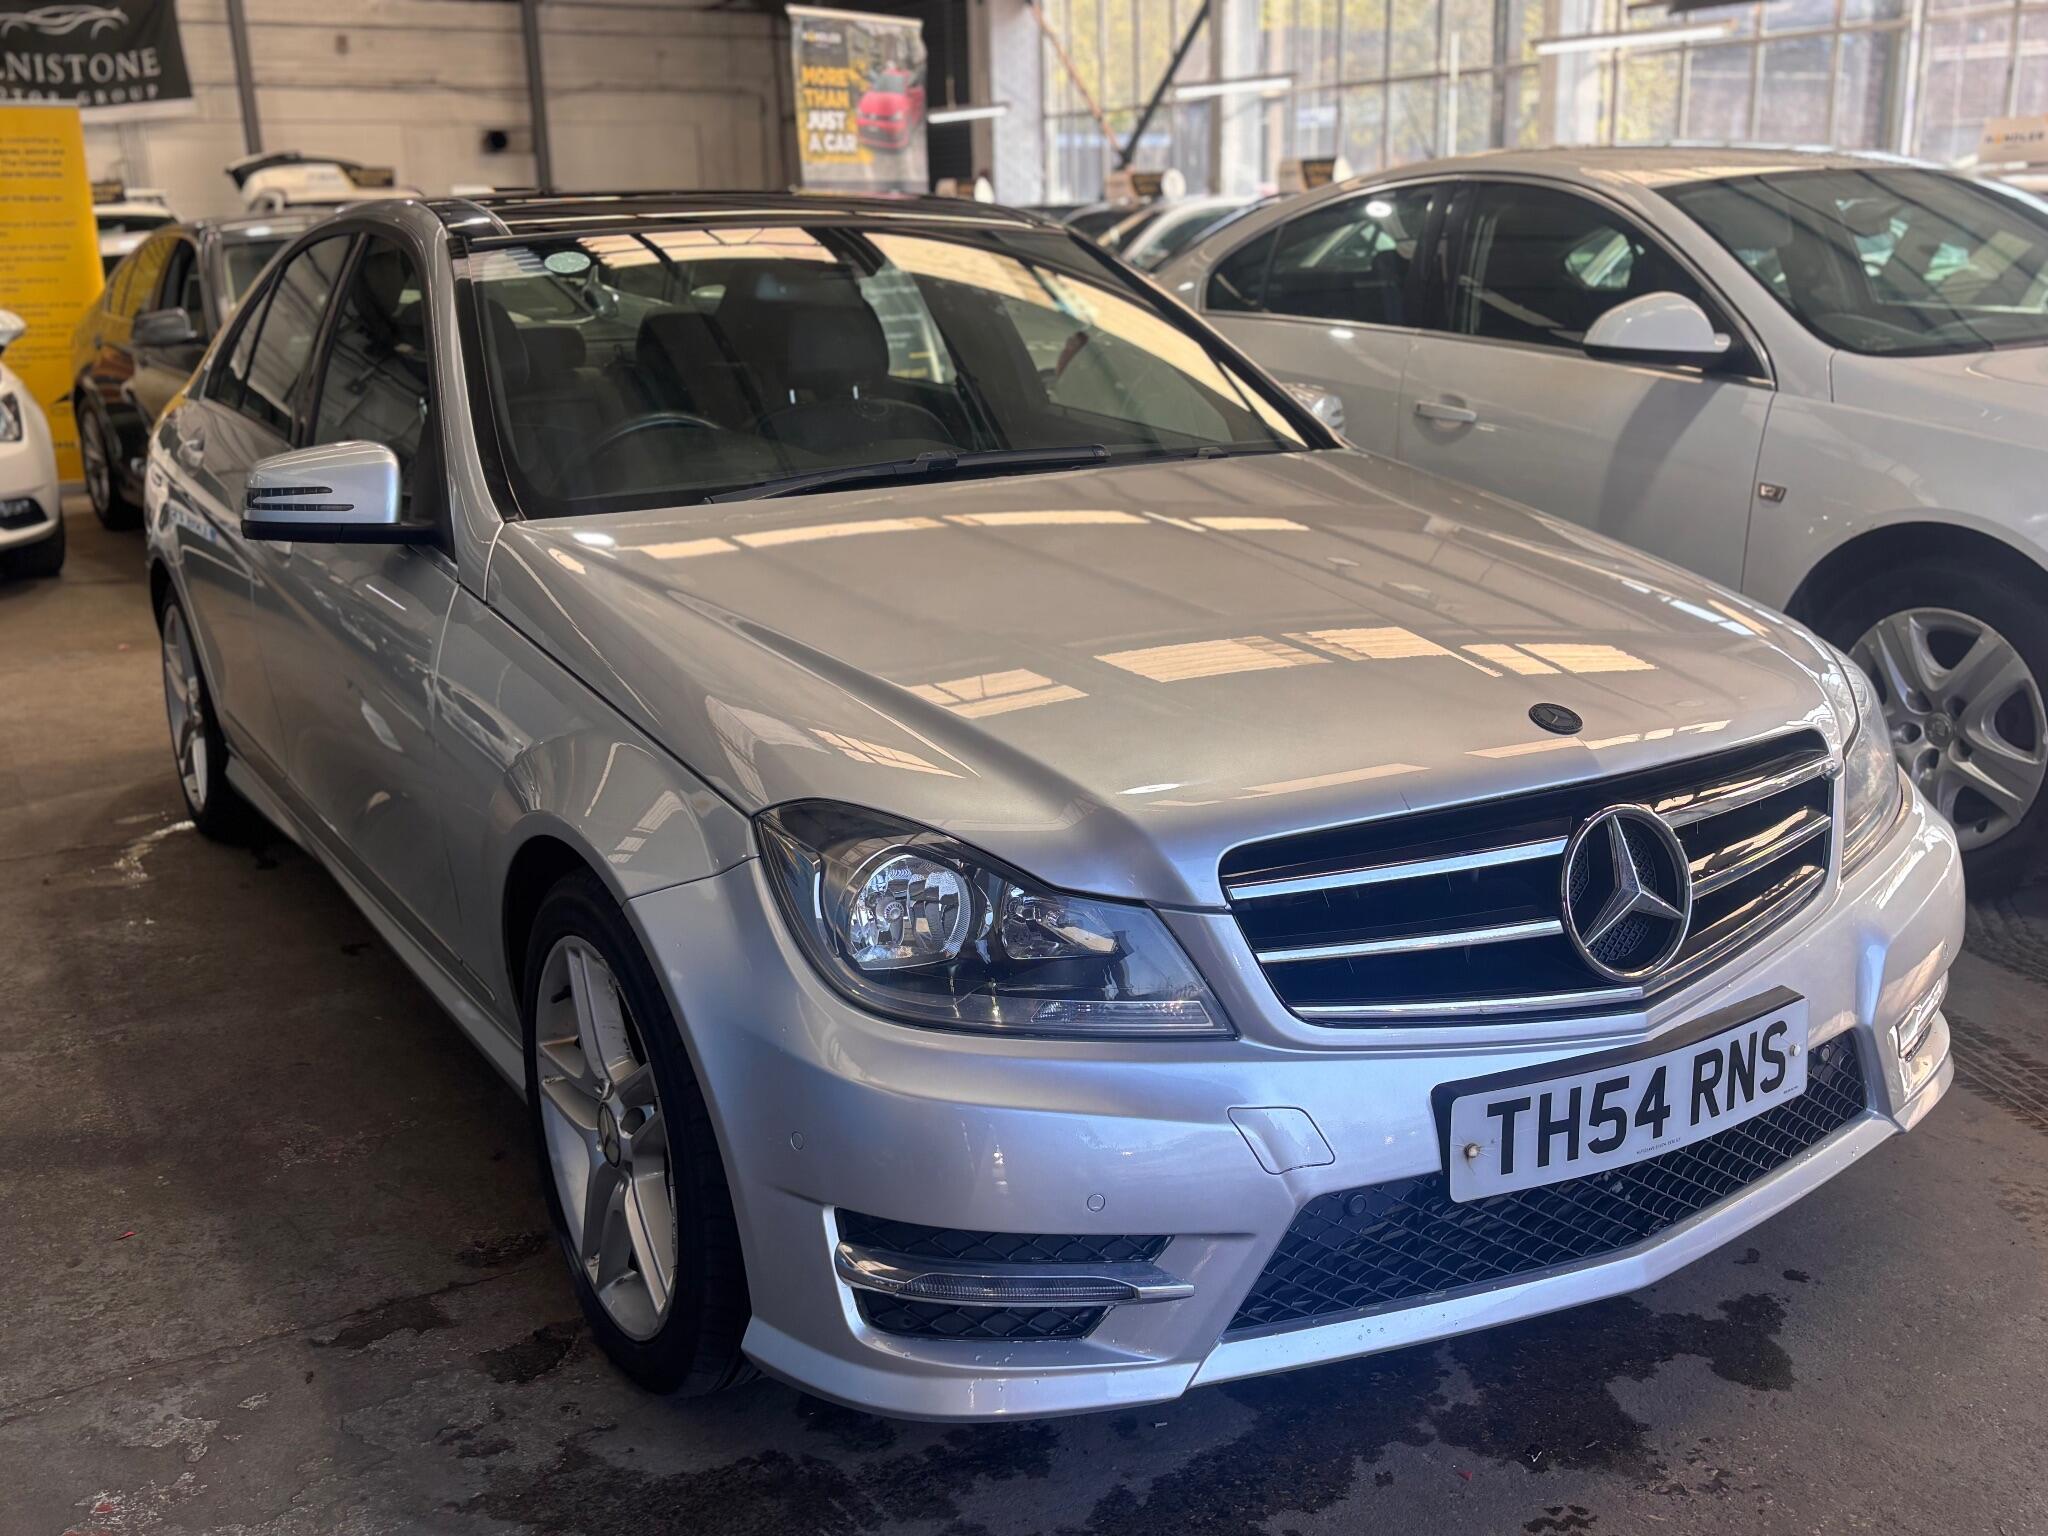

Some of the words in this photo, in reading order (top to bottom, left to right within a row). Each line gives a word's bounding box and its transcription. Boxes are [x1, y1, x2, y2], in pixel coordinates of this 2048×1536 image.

[0, 47, 161, 84] NISTONE
[802, 66, 849, 87] MORE
[76, 84, 159, 106] GROUP
[803, 89, 850, 109] THAN
[806, 110, 846, 131] JUST
[808, 133, 822, 152] A
[823, 133, 857, 153] CAR
[1487, 1065, 1671, 1176] TH54
[1690, 1020, 1788, 1126] RNS
